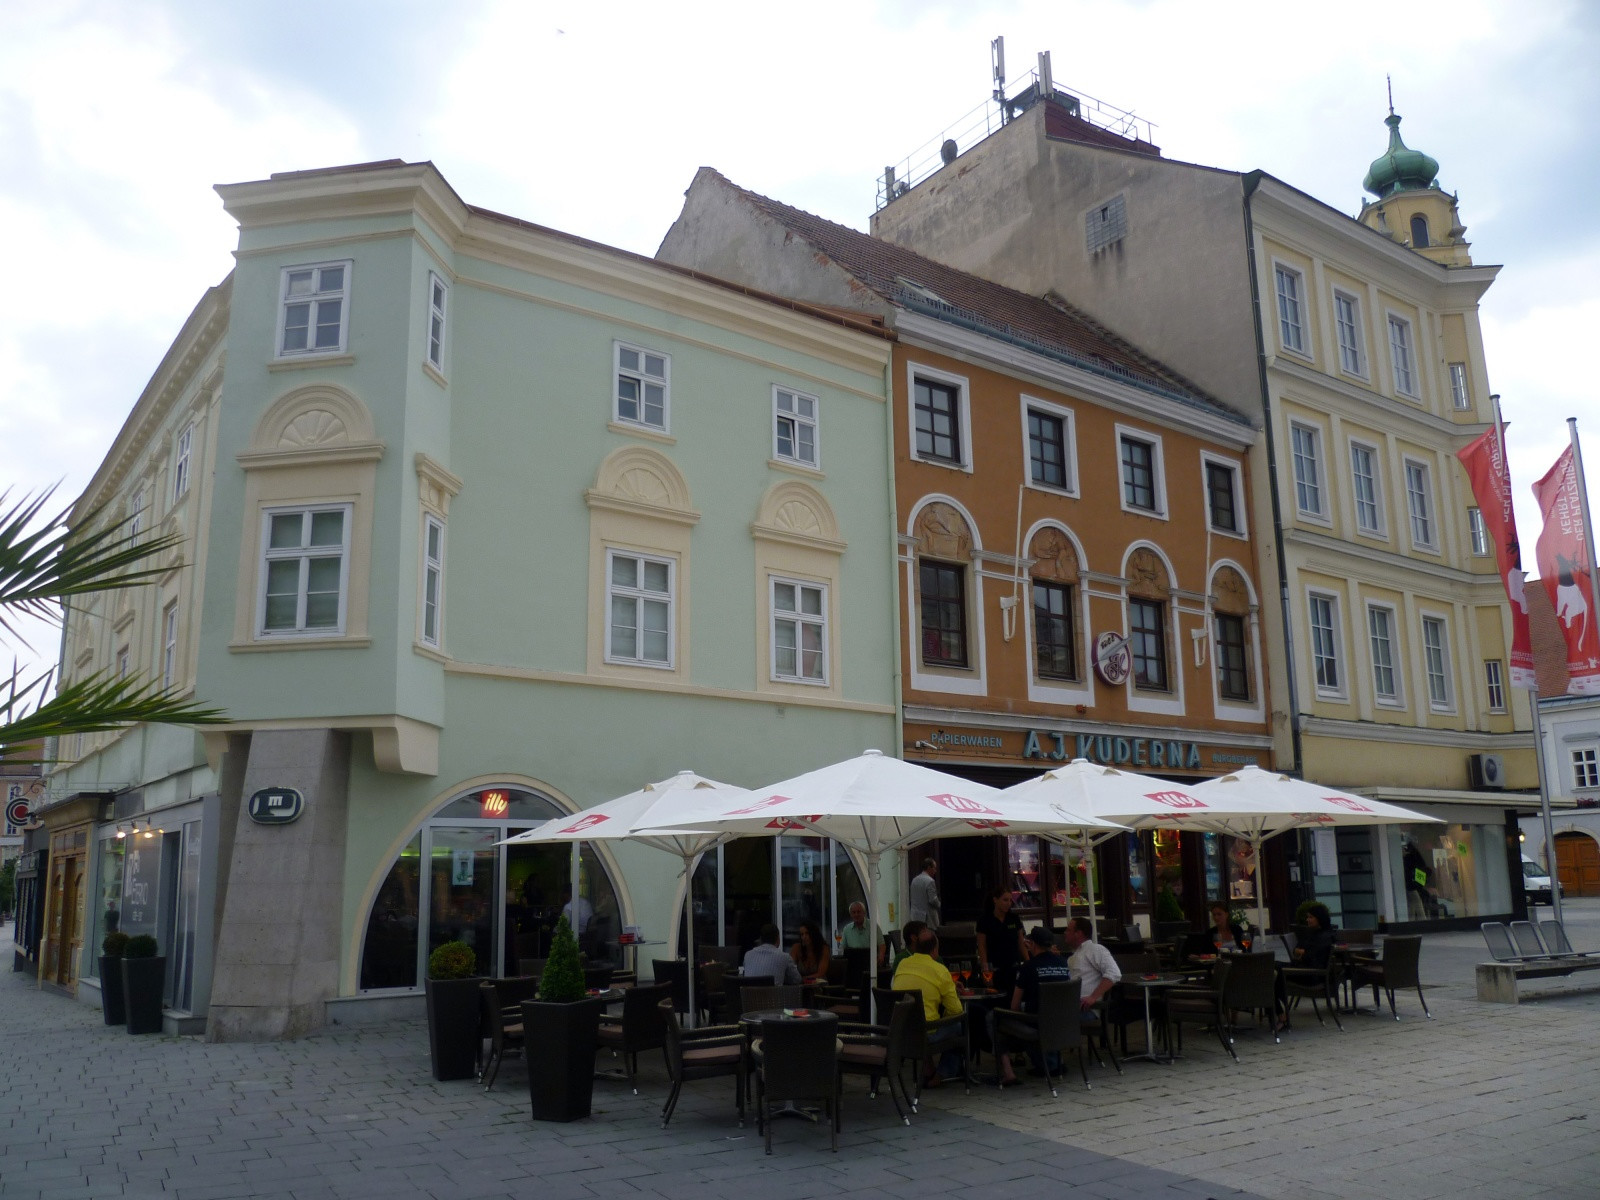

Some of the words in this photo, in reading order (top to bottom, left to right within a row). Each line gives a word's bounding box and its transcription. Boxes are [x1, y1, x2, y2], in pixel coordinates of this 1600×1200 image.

[931, 733, 1002, 748] PAPIERWAREN
[1076, 734, 1202, 769] KUDERNA
[485, 793, 508, 815] illy
[1157, 793, 1196, 807] illy
